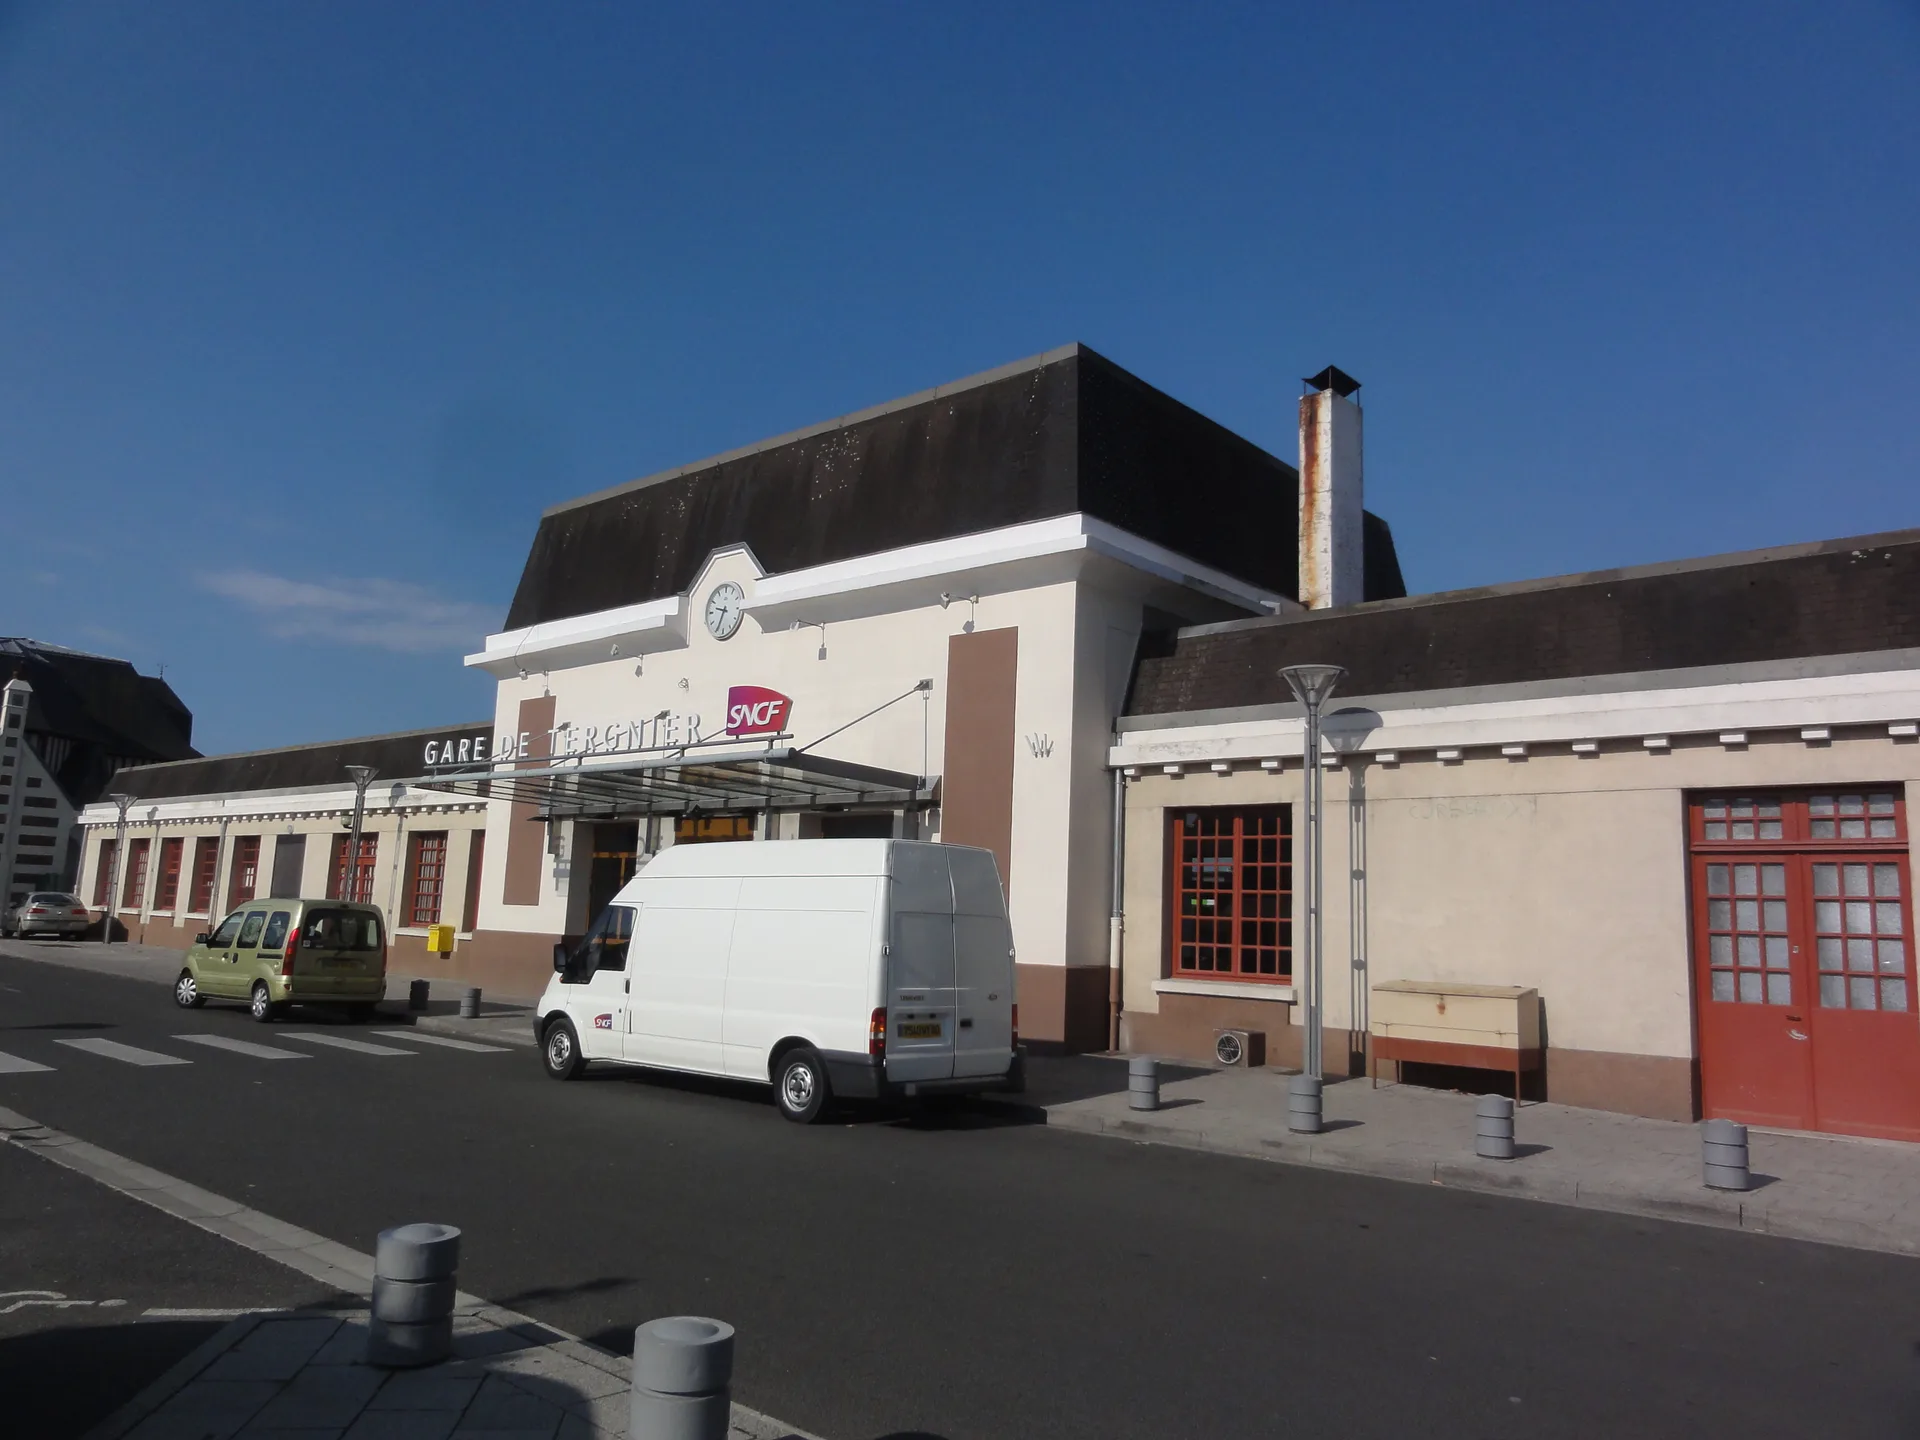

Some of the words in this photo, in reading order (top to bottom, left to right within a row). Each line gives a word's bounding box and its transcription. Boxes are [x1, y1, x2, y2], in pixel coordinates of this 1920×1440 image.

[727, 700, 784, 729] SNCF
[424, 736, 487, 765] GARE
[500, 732, 530, 760] DE
[547, 713, 702, 755] TERGNIER
[595, 1018, 612, 1028] SNCF
